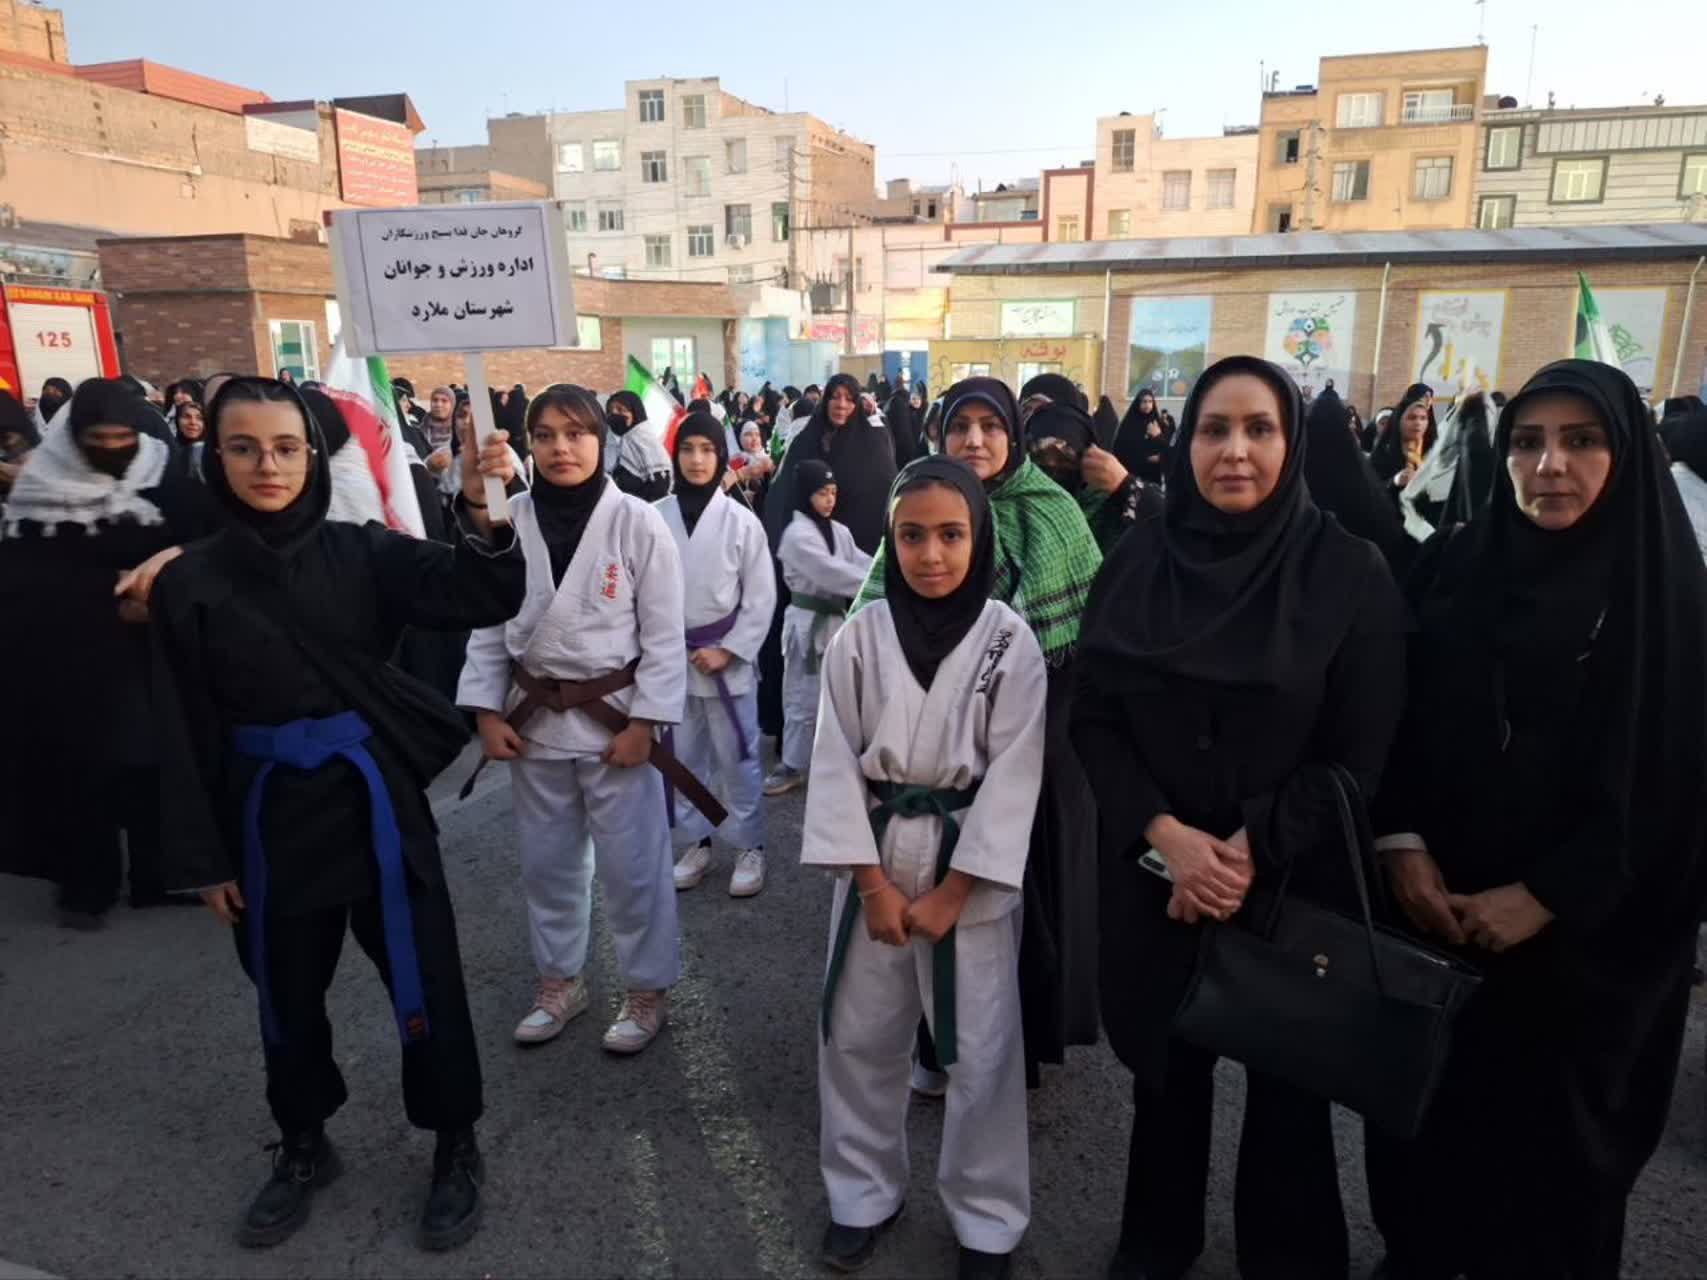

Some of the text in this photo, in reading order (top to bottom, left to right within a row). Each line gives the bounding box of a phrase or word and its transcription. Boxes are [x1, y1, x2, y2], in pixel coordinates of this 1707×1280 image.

[383, 255, 535, 281] اداره ورزش و جوانان
[410, 299, 515, 323] شهرستان ملارد
[36, 331, 72, 348] 125
